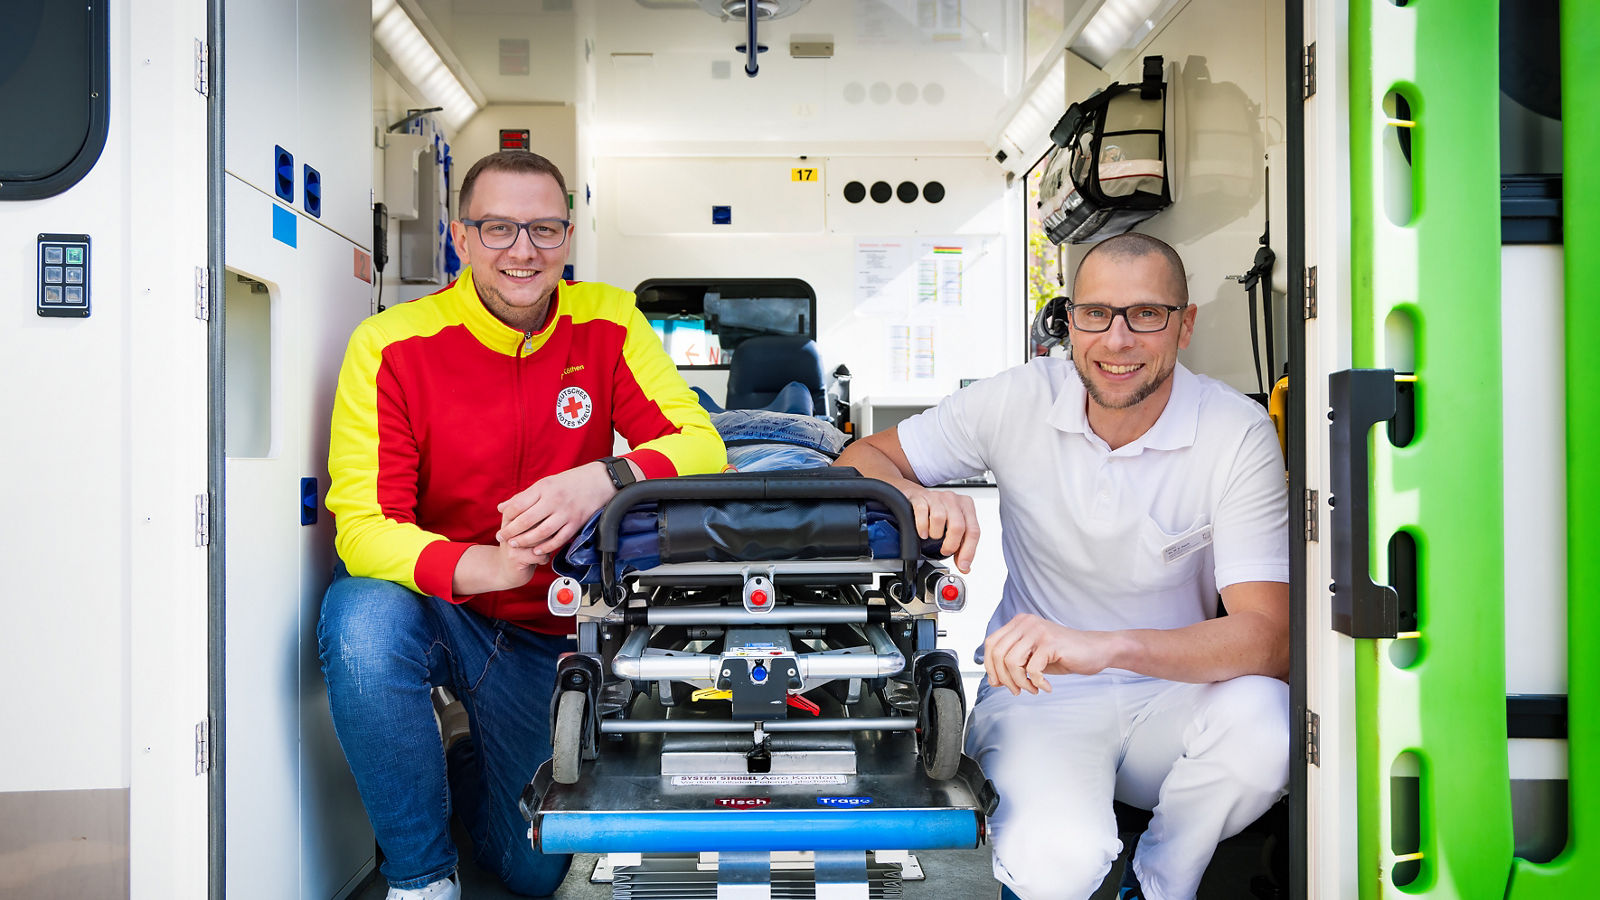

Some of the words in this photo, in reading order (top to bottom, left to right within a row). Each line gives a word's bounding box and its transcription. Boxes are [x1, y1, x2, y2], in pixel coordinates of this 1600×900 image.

[797, 169, 813, 181] 17
[358, 254, 367, 278] 2
[557, 388, 588, 407] DEUTSCHES
[557, 412, 576, 427] ROTES
[577, 404, 591, 425] KREUZ
